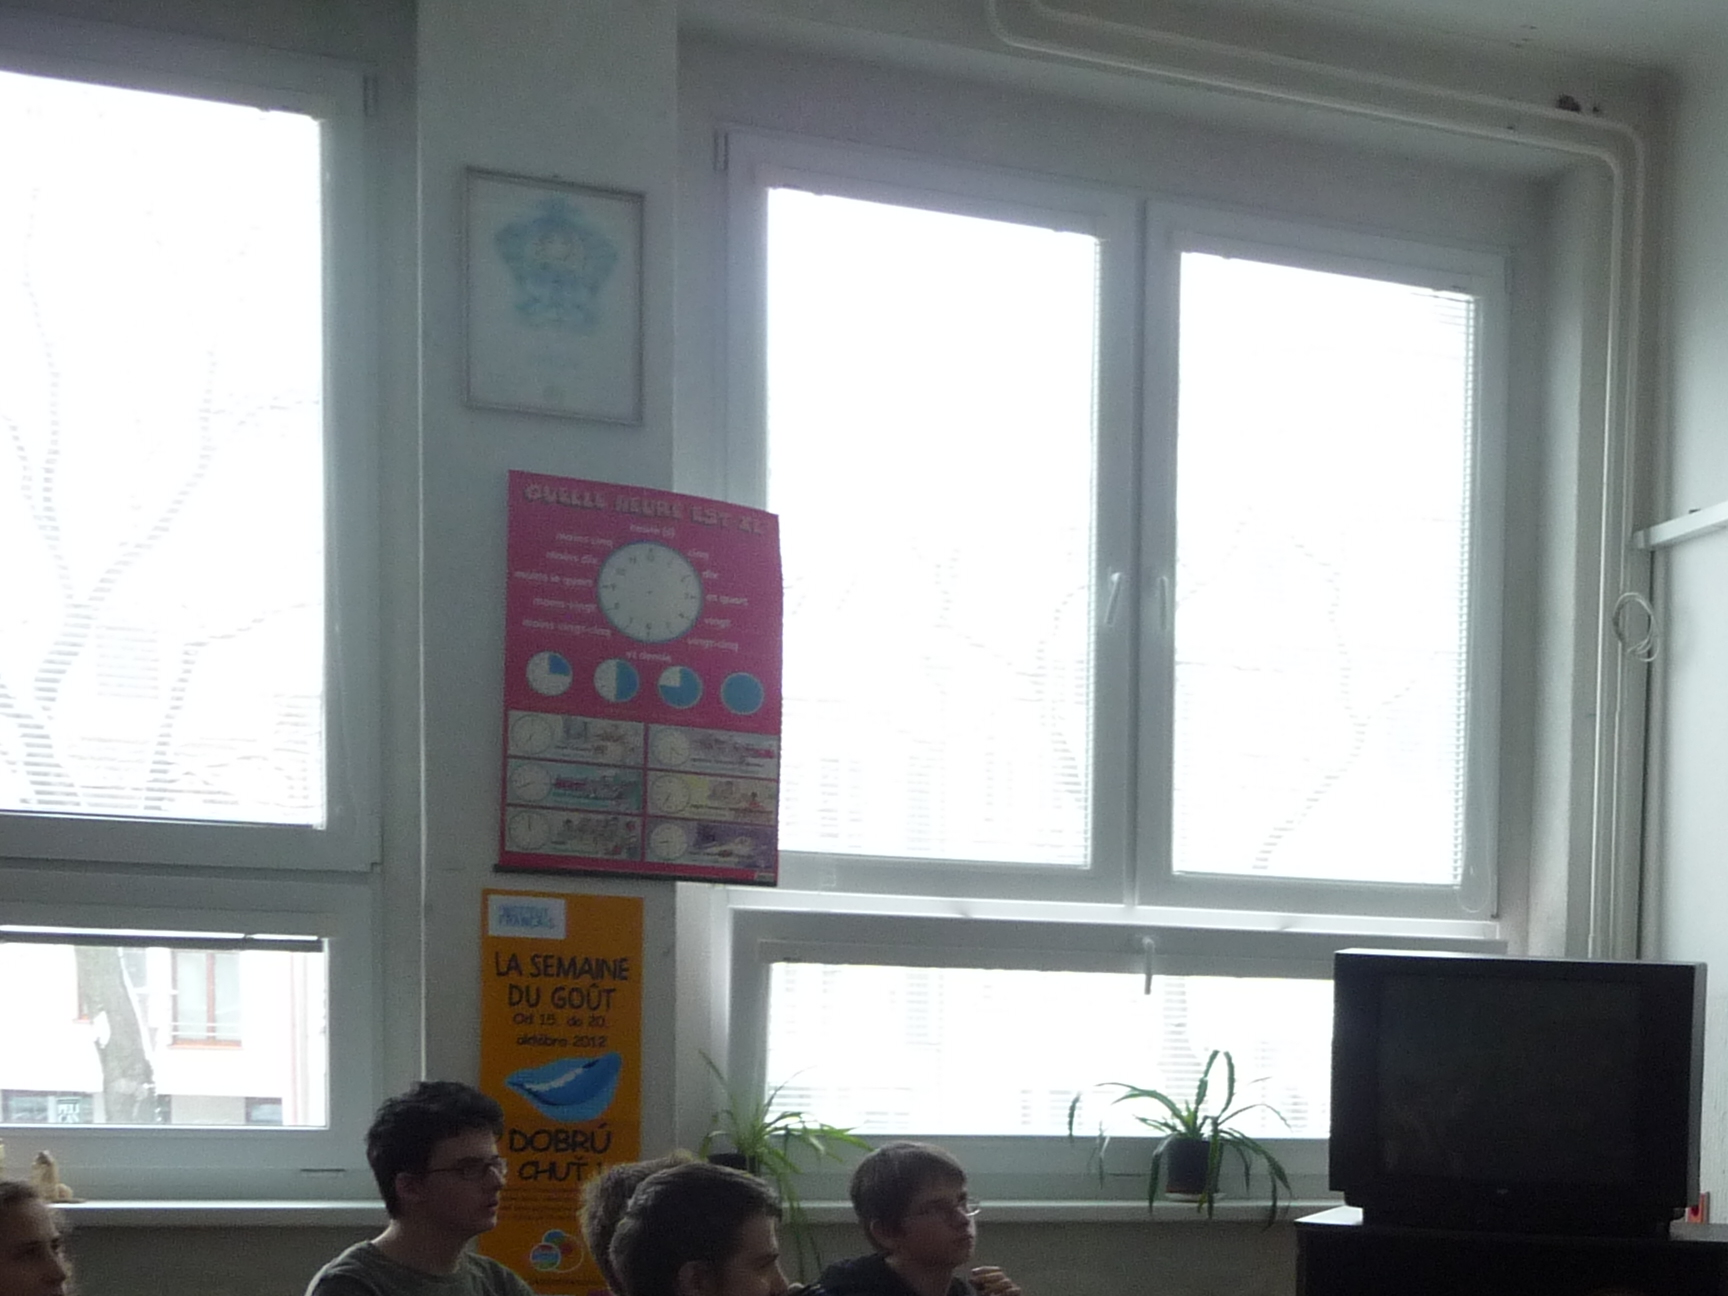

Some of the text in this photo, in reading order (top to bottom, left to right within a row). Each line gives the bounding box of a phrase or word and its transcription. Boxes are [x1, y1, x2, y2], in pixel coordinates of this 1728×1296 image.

[525, 482, 606, 510] QUELLE
[615, 494, 684, 520] HEURE
[691, 505, 731, 529] EST
[495, 951, 630, 981] LA SEMAINE
[508, 982, 616, 1012] DU GOÛT
[572, 1034, 609, 1048] 2012
[509, 1122, 612, 1154] DOBRÚ
[518, 1155, 589, 1182] CHUŤ
